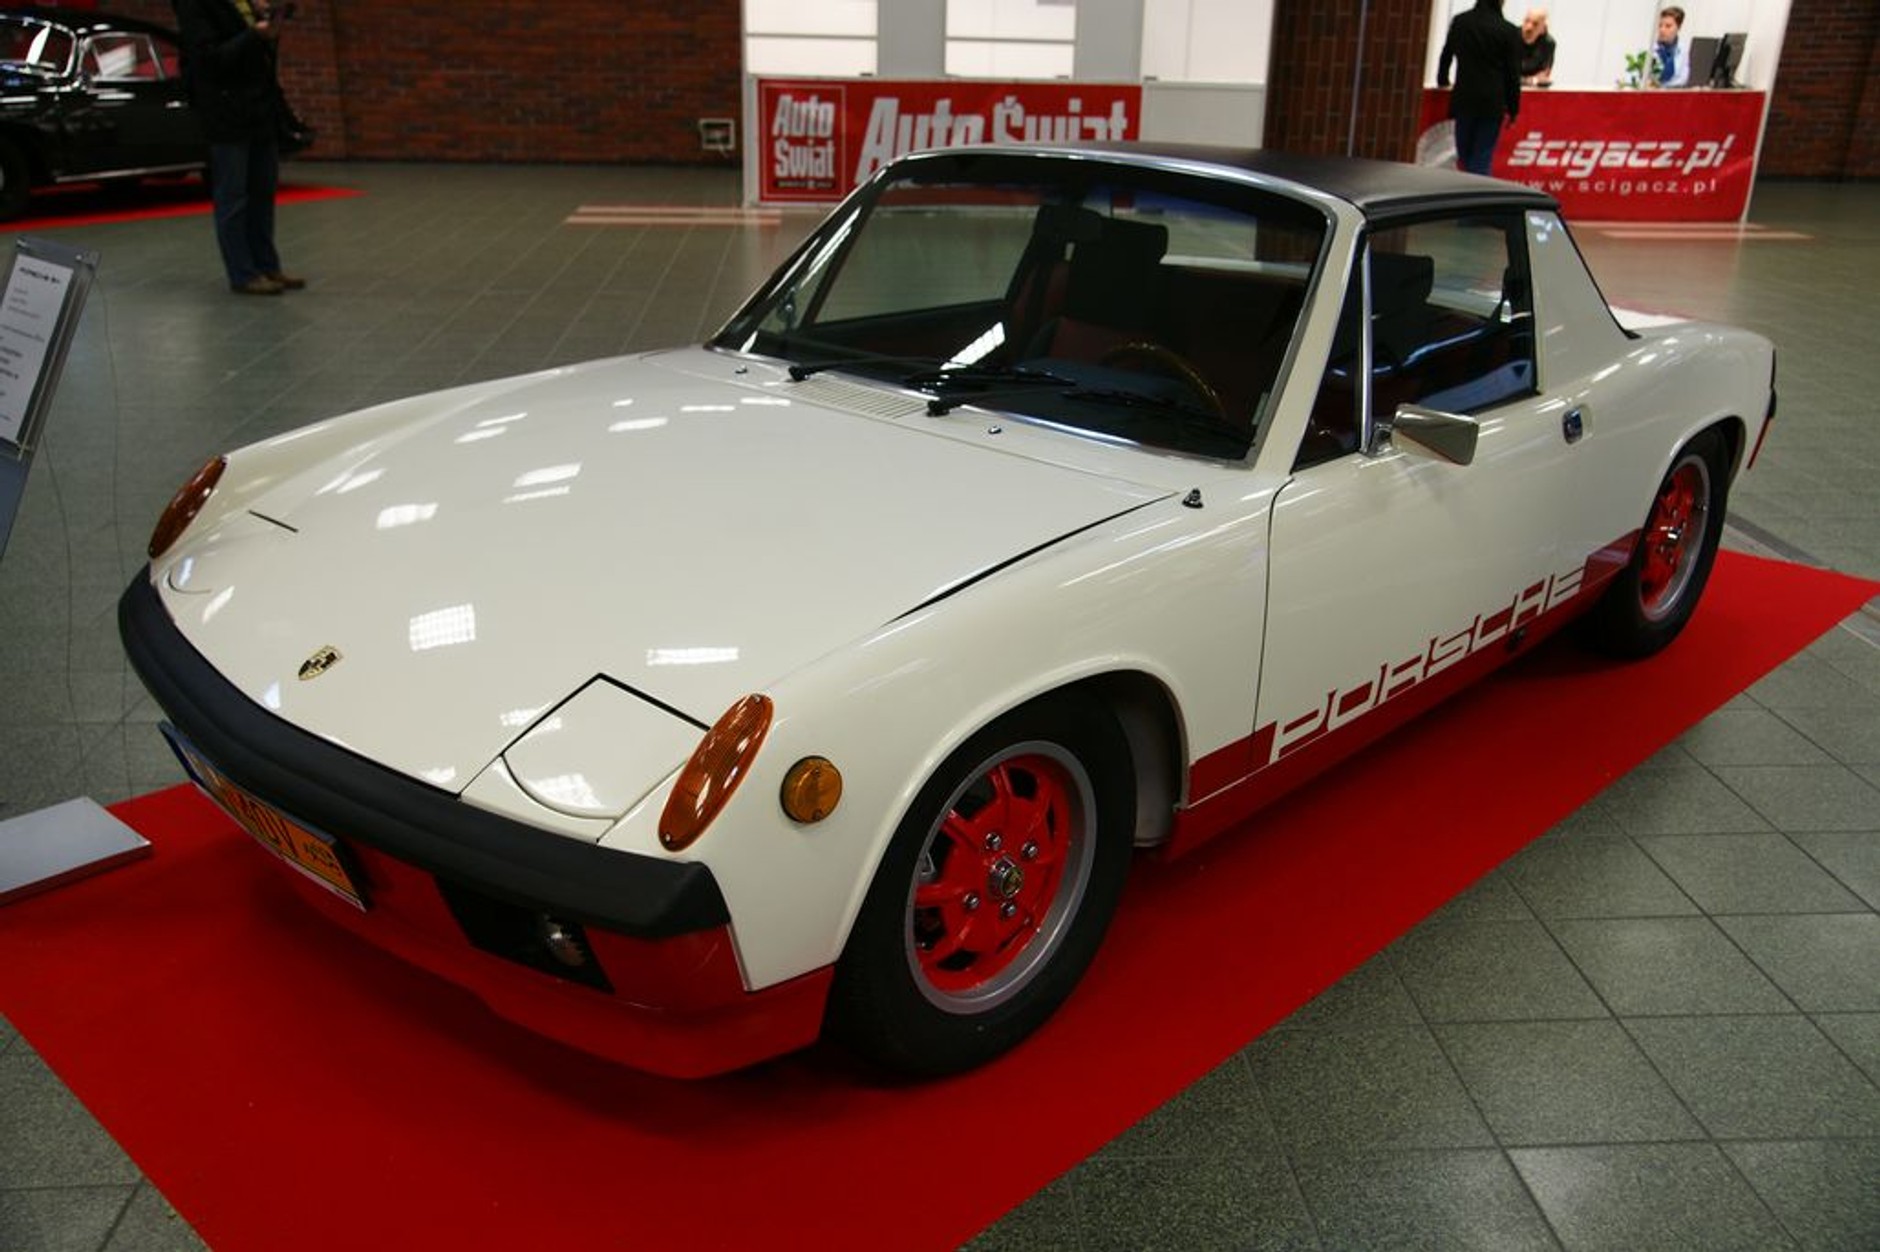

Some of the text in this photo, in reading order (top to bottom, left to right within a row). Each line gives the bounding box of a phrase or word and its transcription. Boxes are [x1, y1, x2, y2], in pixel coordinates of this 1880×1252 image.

[772, 95, 834, 136] Auto
[1507, 131, 1735, 178] ścigacz.pl
[1514, 178, 1717, 193] ww.scigacz.pl
[1268, 565, 1585, 765] PORSCHE
